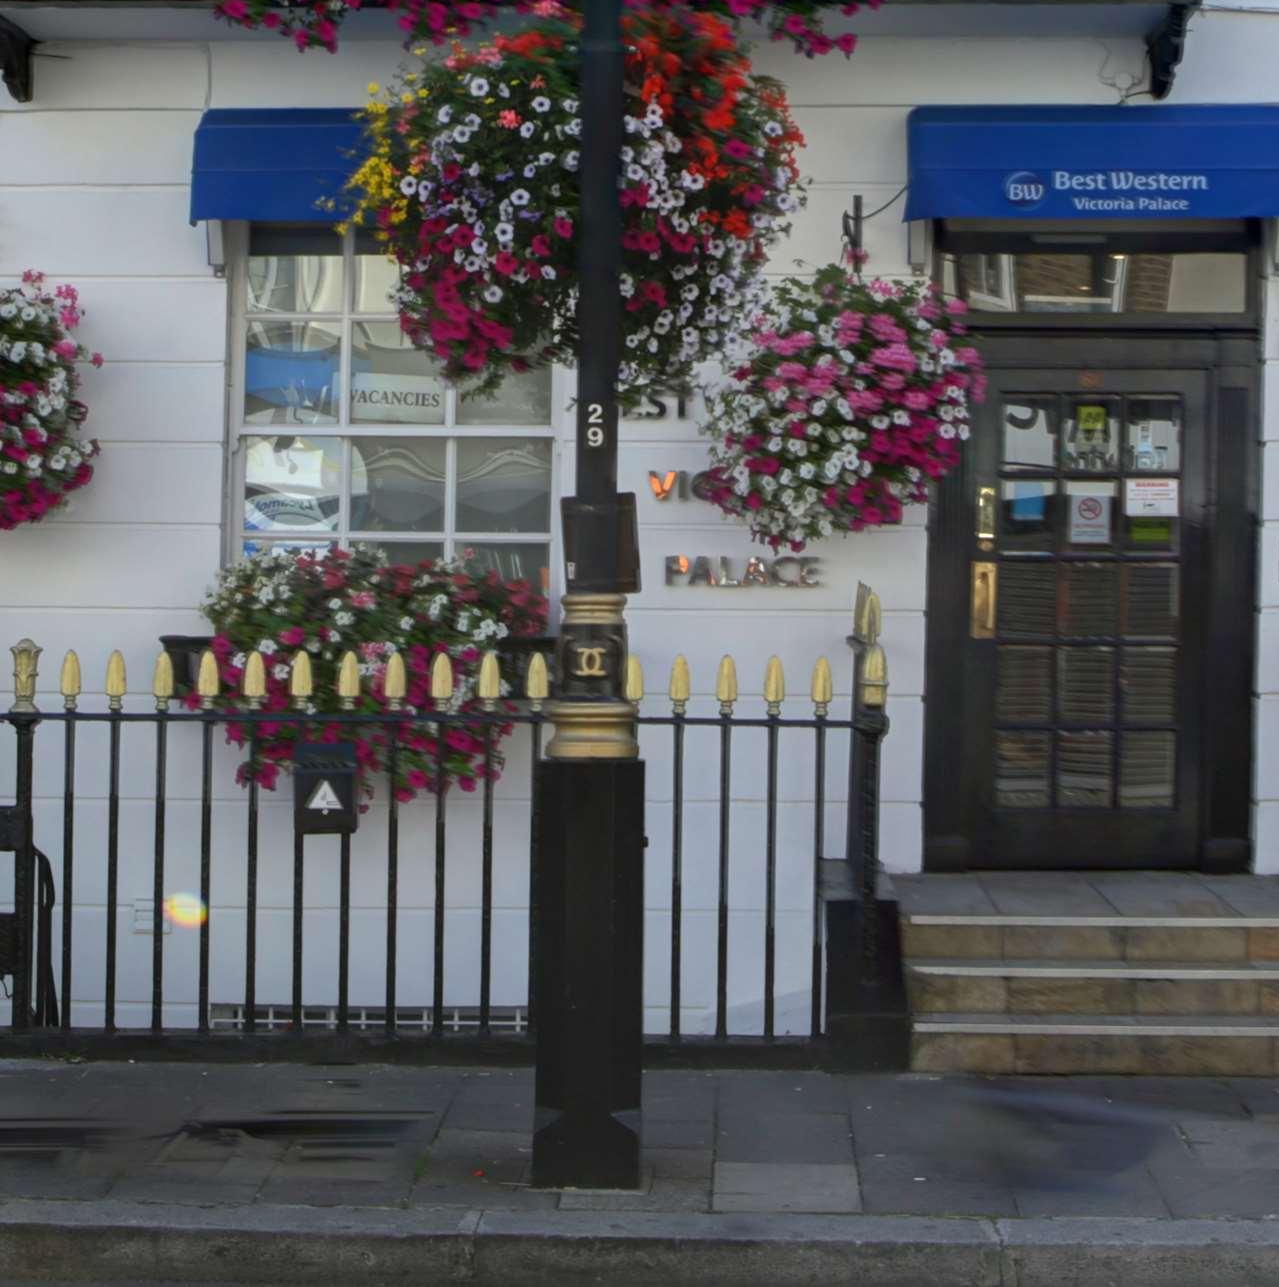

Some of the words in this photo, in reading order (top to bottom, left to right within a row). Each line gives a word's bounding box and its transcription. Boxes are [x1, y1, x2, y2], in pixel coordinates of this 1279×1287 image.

[1054, 171, 1106, 190] Best
[1111, 171, 1209, 190] Western
[1008, 183, 1044, 201] BW
[1074, 197, 1134, 211] Victoria
[1139, 197, 1190, 211] Palace
[351, 390, 441, 409] VACANCIES
[665, 554, 824, 587] PALACE
